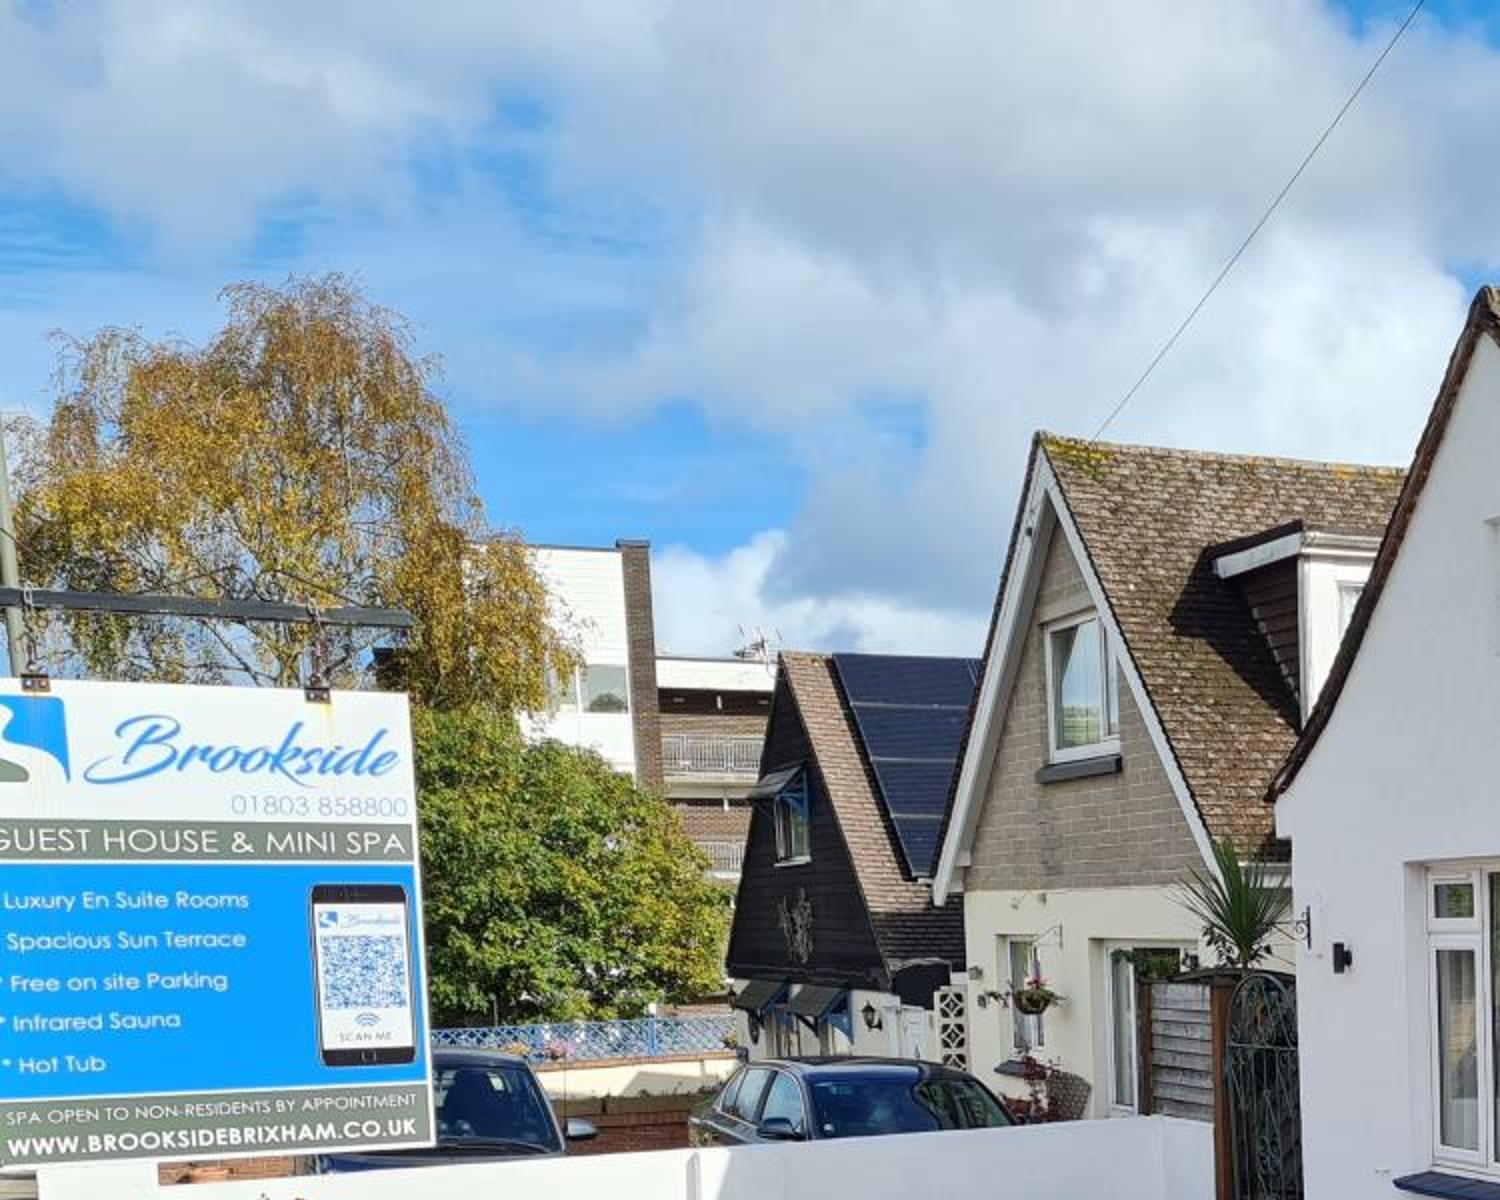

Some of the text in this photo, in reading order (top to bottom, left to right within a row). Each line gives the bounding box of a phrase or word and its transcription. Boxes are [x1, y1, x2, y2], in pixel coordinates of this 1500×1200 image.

[83, 714, 399, 788] Brookside
[231, 795, 409, 818] 01803 858800
[103, 828, 219, 853] HOUSE
[231, 831, 255, 853] &
[266, 831, 336, 854] MINI
[346, 831, 406, 855] SPA
[4, 890, 249, 913] Luxury En Suite Rooms
[6, 931, 246, 954] Spacious Sun Terrace
[10, 972, 228, 992] Free on site Parking
[13, 1011, 181, 1032] Infrared Sauna
[19, 1055, 106, 1073] Hot Tub
[6, 1110, 42, 1125] SPA
[47, 1108, 99, 1124] OPEN
[105, 1106, 129, 1121] TO
[275, 1099, 295, 1113] BY
[301, 1093, 417, 1112] APPOINTMENT
[7, 1118, 417, 1156] WWW.BROOKSIDEBRIXHAM.CO.UK
